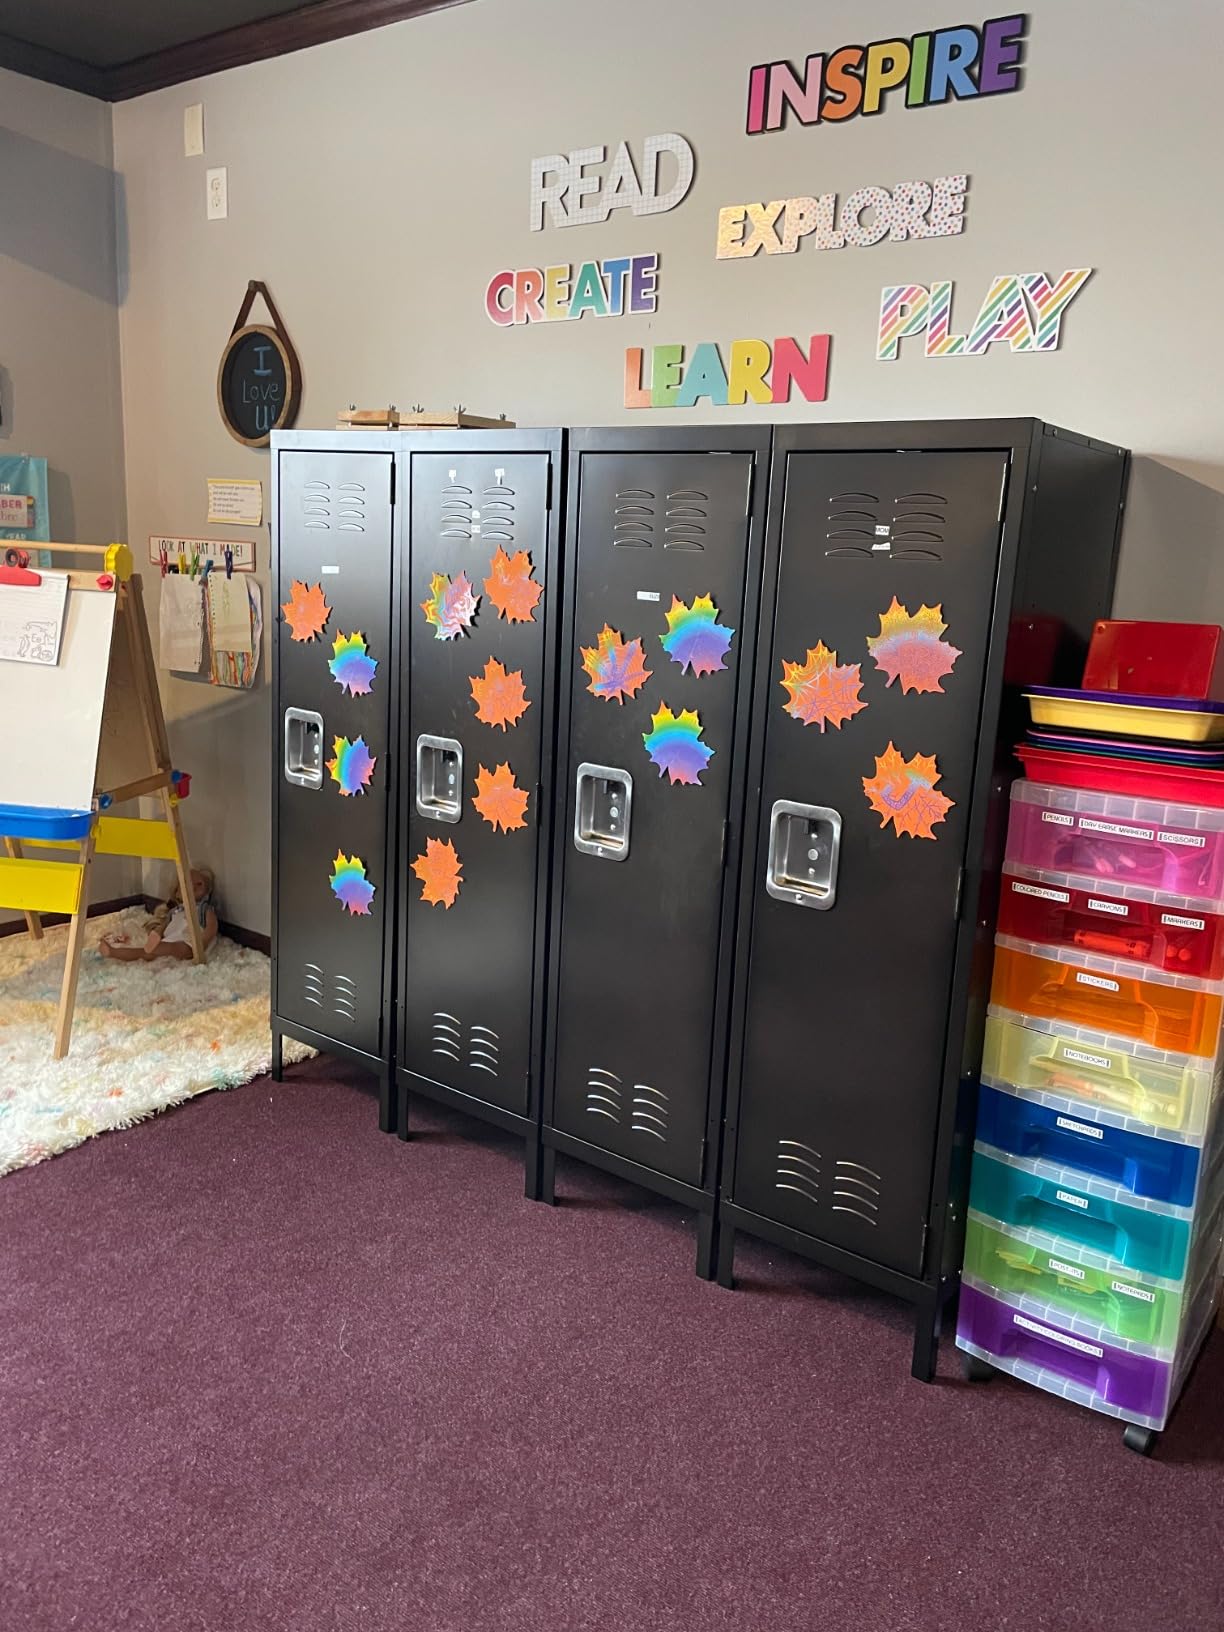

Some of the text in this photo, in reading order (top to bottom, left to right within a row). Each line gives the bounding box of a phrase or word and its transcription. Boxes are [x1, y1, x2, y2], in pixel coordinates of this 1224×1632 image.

[747, 14, 1026, 135] INSPIRE
[530, 132, 695, 231] READ
[717, 175, 968, 259] EXPLORE
[486, 253, 658, 327] CREATE
[876, 268, 1094, 360] PLAY
[254, 346, 272, 376] I
[624, 335, 832, 408] LEARN
[243, 380, 280, 403] Love
[178, 541, 185, 553] AT
[1046, 814, 1069, 824] PENCILS
[1016, 884, 1065, 900] COLORED PENCILS
[1093, 902, 1123, 913] CRAYONS
[1167, 917, 1199, 928] MARKERS
[1082, 976, 1114, 989] STICKERS
[1068, 1050, 1106, 1066] NOTEBOOKS
[1062, 1119, 1098, 1136] SKETCHPADS
[1117, 1283, 1150, 1299] NOTEPADS
